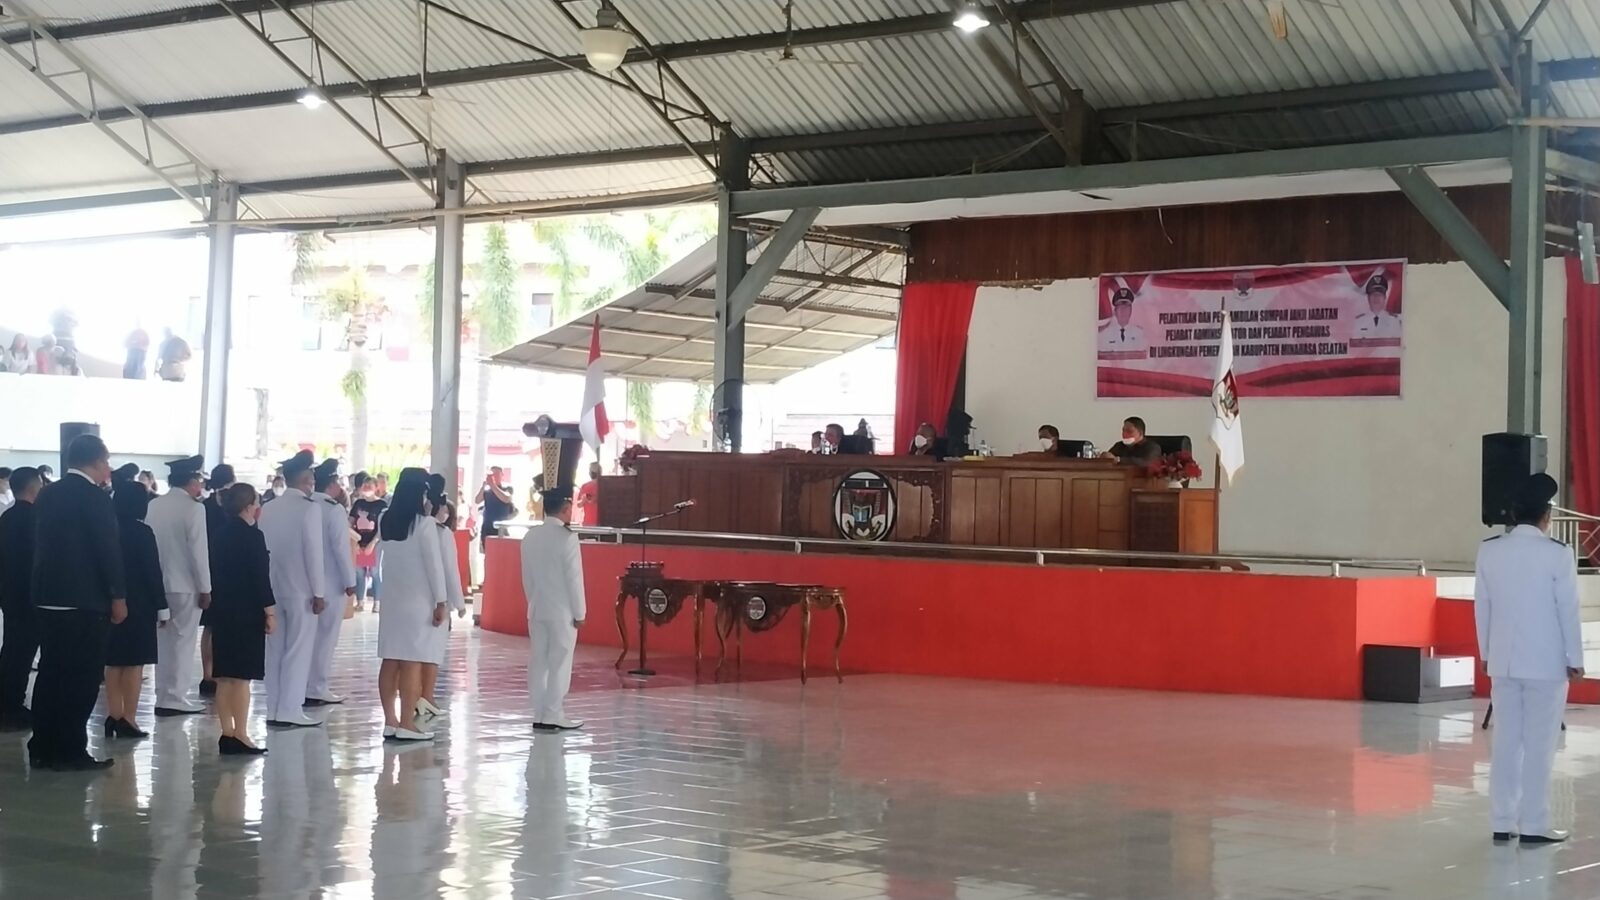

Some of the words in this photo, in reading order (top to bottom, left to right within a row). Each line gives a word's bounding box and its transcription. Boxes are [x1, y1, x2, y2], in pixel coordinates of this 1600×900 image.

[1159, 312, 1197, 324] PELANTIKAN
[1198, 311, 1211, 323] DAN
[1212, 310, 1258, 323] PEAMBILAN
[1259, 309, 1288, 322] SUMPAH
[1308, 307, 1338, 320] JABATAN
[1166, 329, 1192, 341] PEJABAT
[1193, 327, 1247, 340] ADMINISATOR
[1248, 327, 1262, 339] DAN
[1263, 326, 1291, 338] PEJABAT
[1292, 325, 1330, 338] PENGAWAS
[1149, 346, 1156, 358] DI
[1158, 345, 1197, 358] LINGKUNGAN
[1241, 343, 1280, 356] KABUPATEN
[1281, 343, 1317, 355] MINAHASA
[1318, 342, 1348, 355] SELATAN
